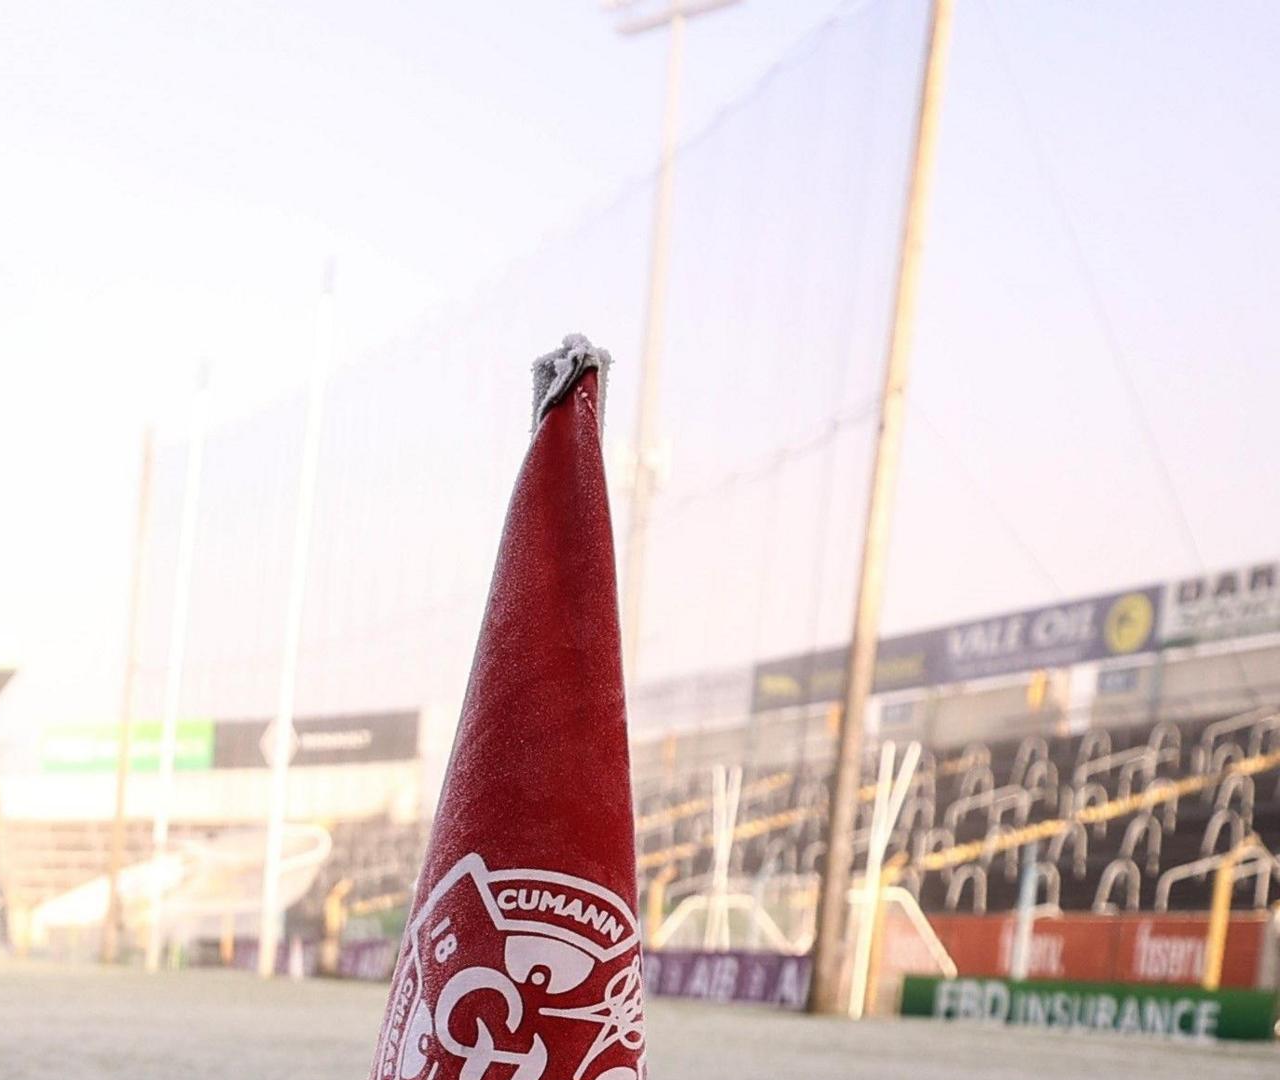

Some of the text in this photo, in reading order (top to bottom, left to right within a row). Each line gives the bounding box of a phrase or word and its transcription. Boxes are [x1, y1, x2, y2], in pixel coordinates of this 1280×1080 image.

[945, 602, 1098, 659] VALE OIL
[430, 916, 458, 963] 18
[497, 888, 624, 944] CUMANN
[933, 976, 1222, 1046] FBD INSURANCE
